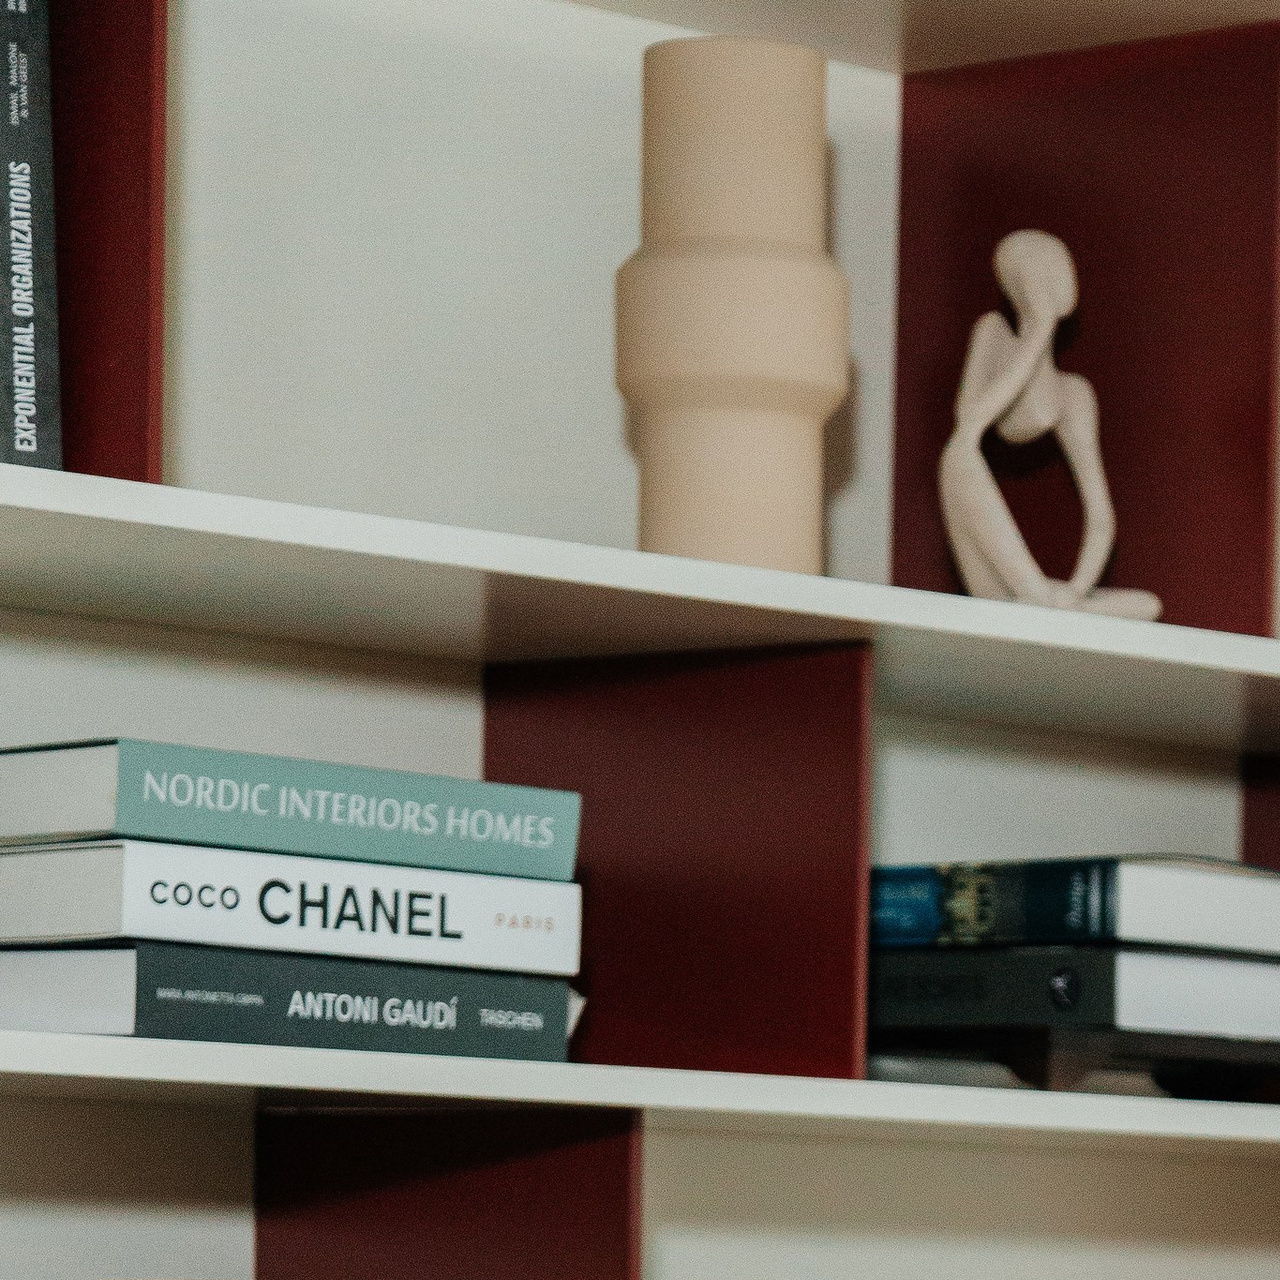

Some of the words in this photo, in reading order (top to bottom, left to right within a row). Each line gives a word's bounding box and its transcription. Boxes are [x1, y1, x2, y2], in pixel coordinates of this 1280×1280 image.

[8, 161, 34, 317] ORGANIZATIONS
[13, 322, 37, 452] EXPONENTIAL
[143, 770, 269, 816] NORDIC
[278, 786, 438, 836] INTERIORS
[445, 806, 555, 849] HOMES
[150, 879, 240, 910] COCO
[258, 877, 464, 940] CHANEL
[494, 911, 555, 933] PARIS
[286, 990, 378, 1024] ANTONI
[382, 996, 458, 1030] GAUDÍ
[479, 1008, 543, 1031] TASCHEN
